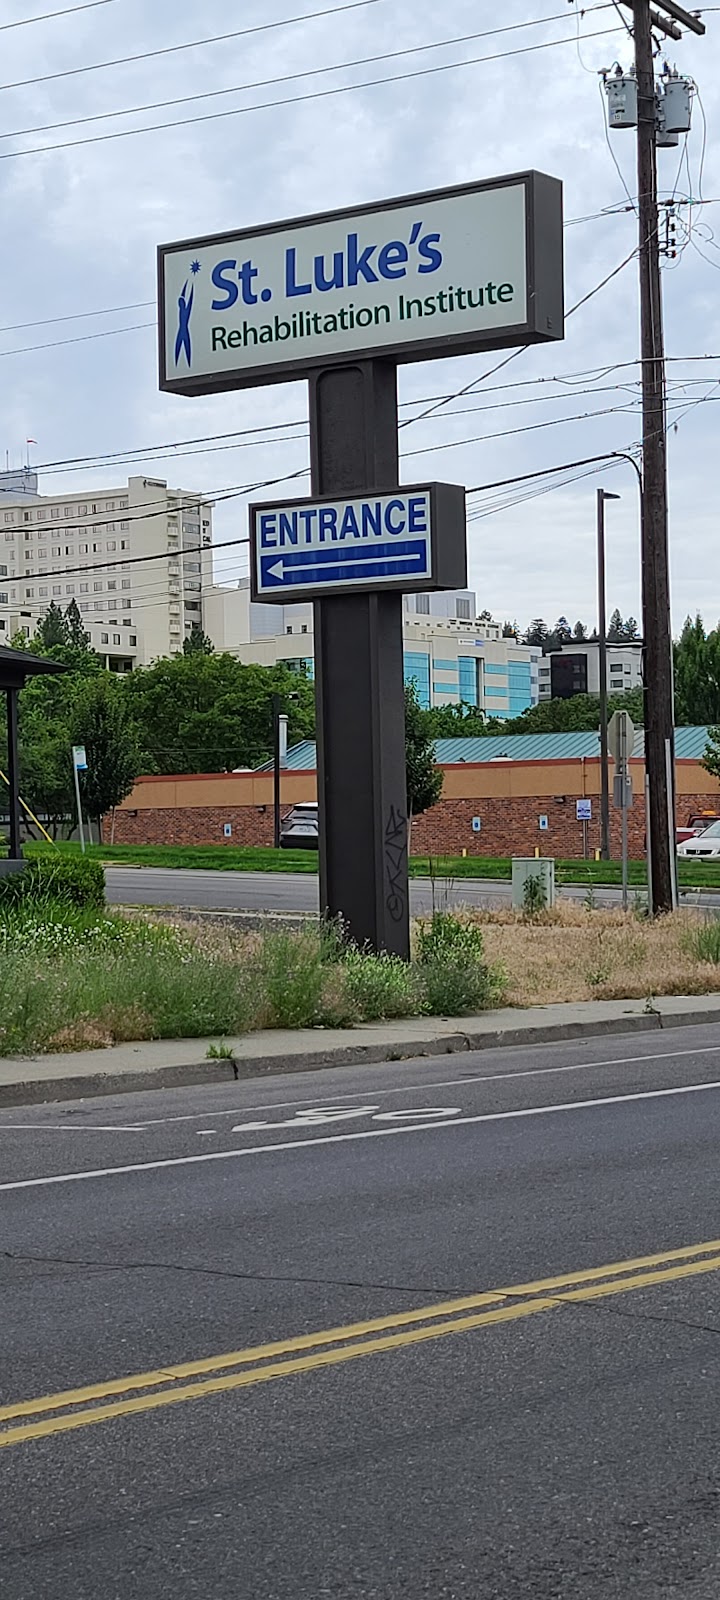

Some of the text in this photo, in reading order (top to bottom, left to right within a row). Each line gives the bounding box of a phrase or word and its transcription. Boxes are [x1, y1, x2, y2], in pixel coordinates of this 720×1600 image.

[211, 221, 442, 310] St. Luke's
[211, 281, 514, 351] Rehabilitation Institute
[260, 497, 427, 548] ENTRANCE
